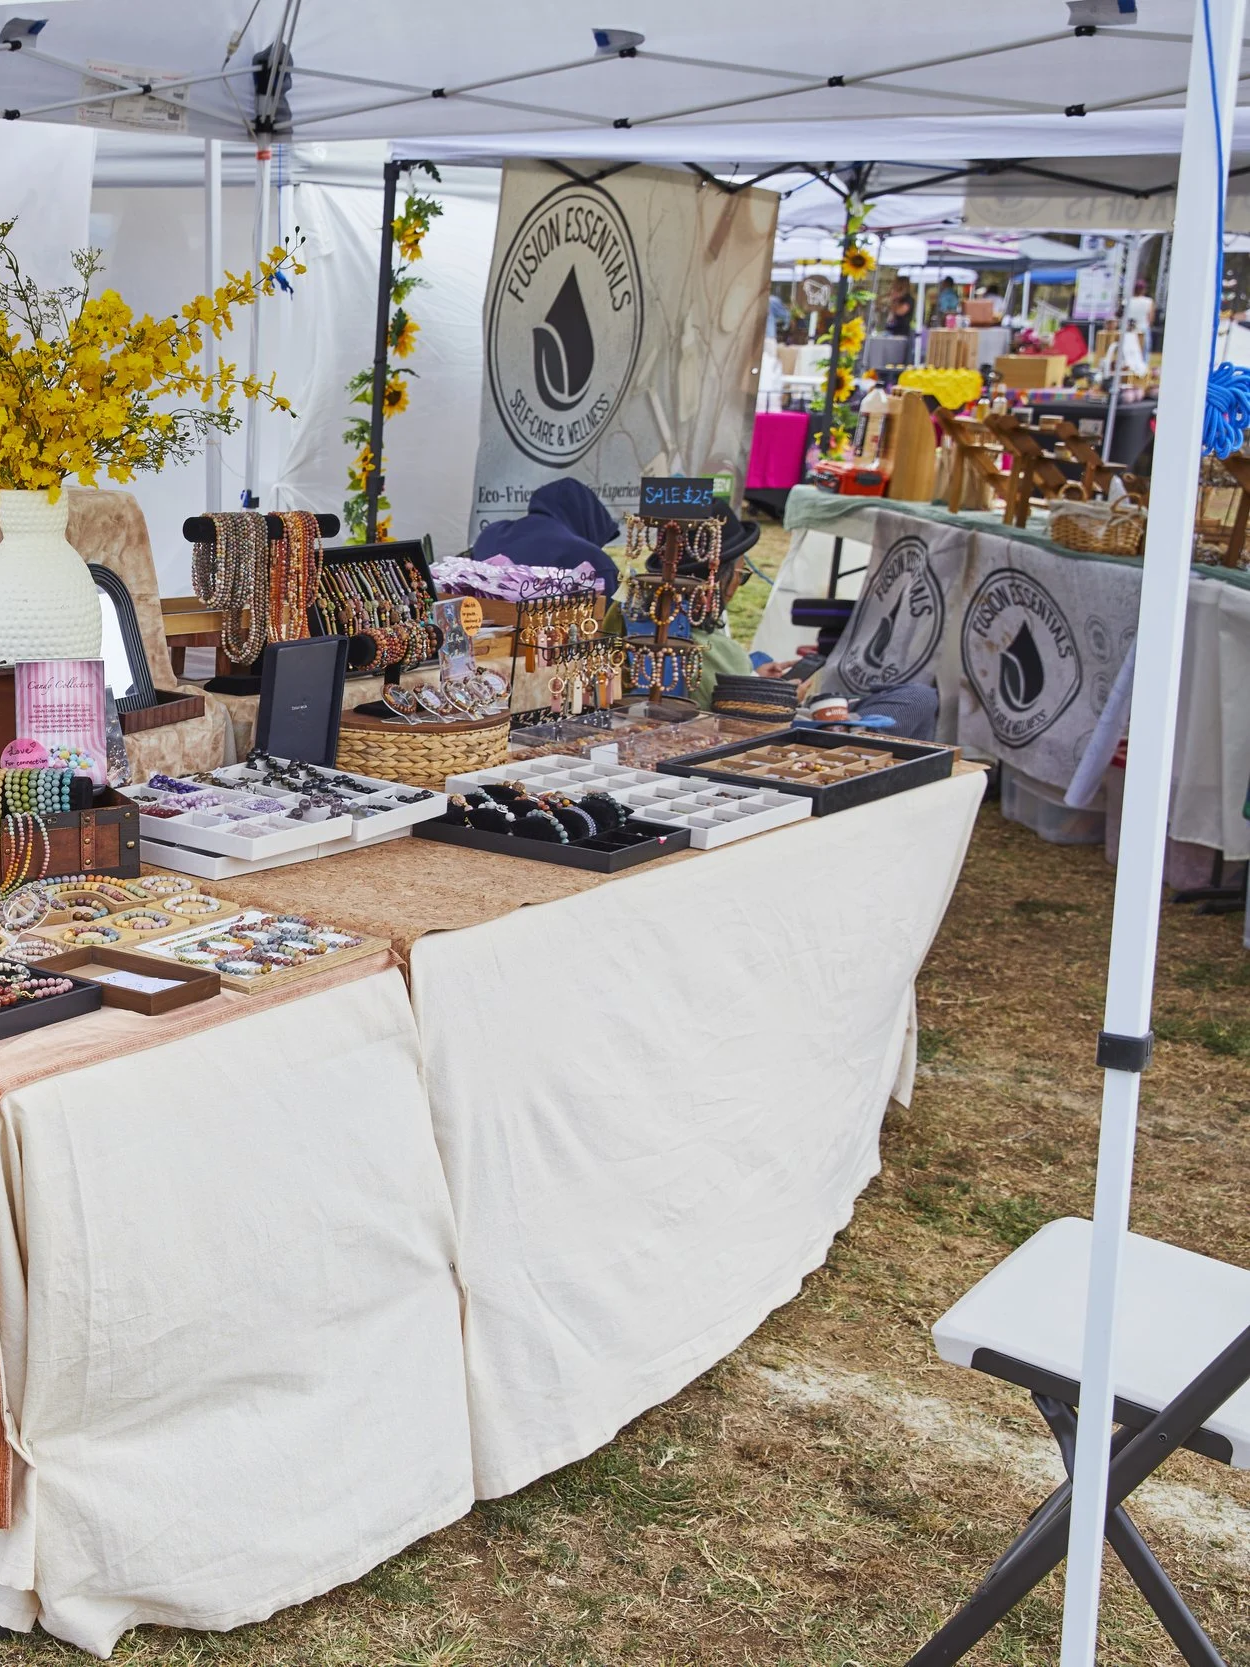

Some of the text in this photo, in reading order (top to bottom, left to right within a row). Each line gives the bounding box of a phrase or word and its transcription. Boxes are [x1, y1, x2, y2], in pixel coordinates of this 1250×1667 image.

[507, 206, 632, 312] FUSION ESSENTIALS
[509, 388, 610, 447] SELF-CARE & WELLNESS
[645, 485, 681, 505] SALE
[681, 484, 714, 507] $25
[972, 581, 1072, 659] FUSION ESSENTIALS
[27, 676, 95, 696] Candy Collection
[7, 746, 31, 756] Love
[16, 757, 48, 767] connection
